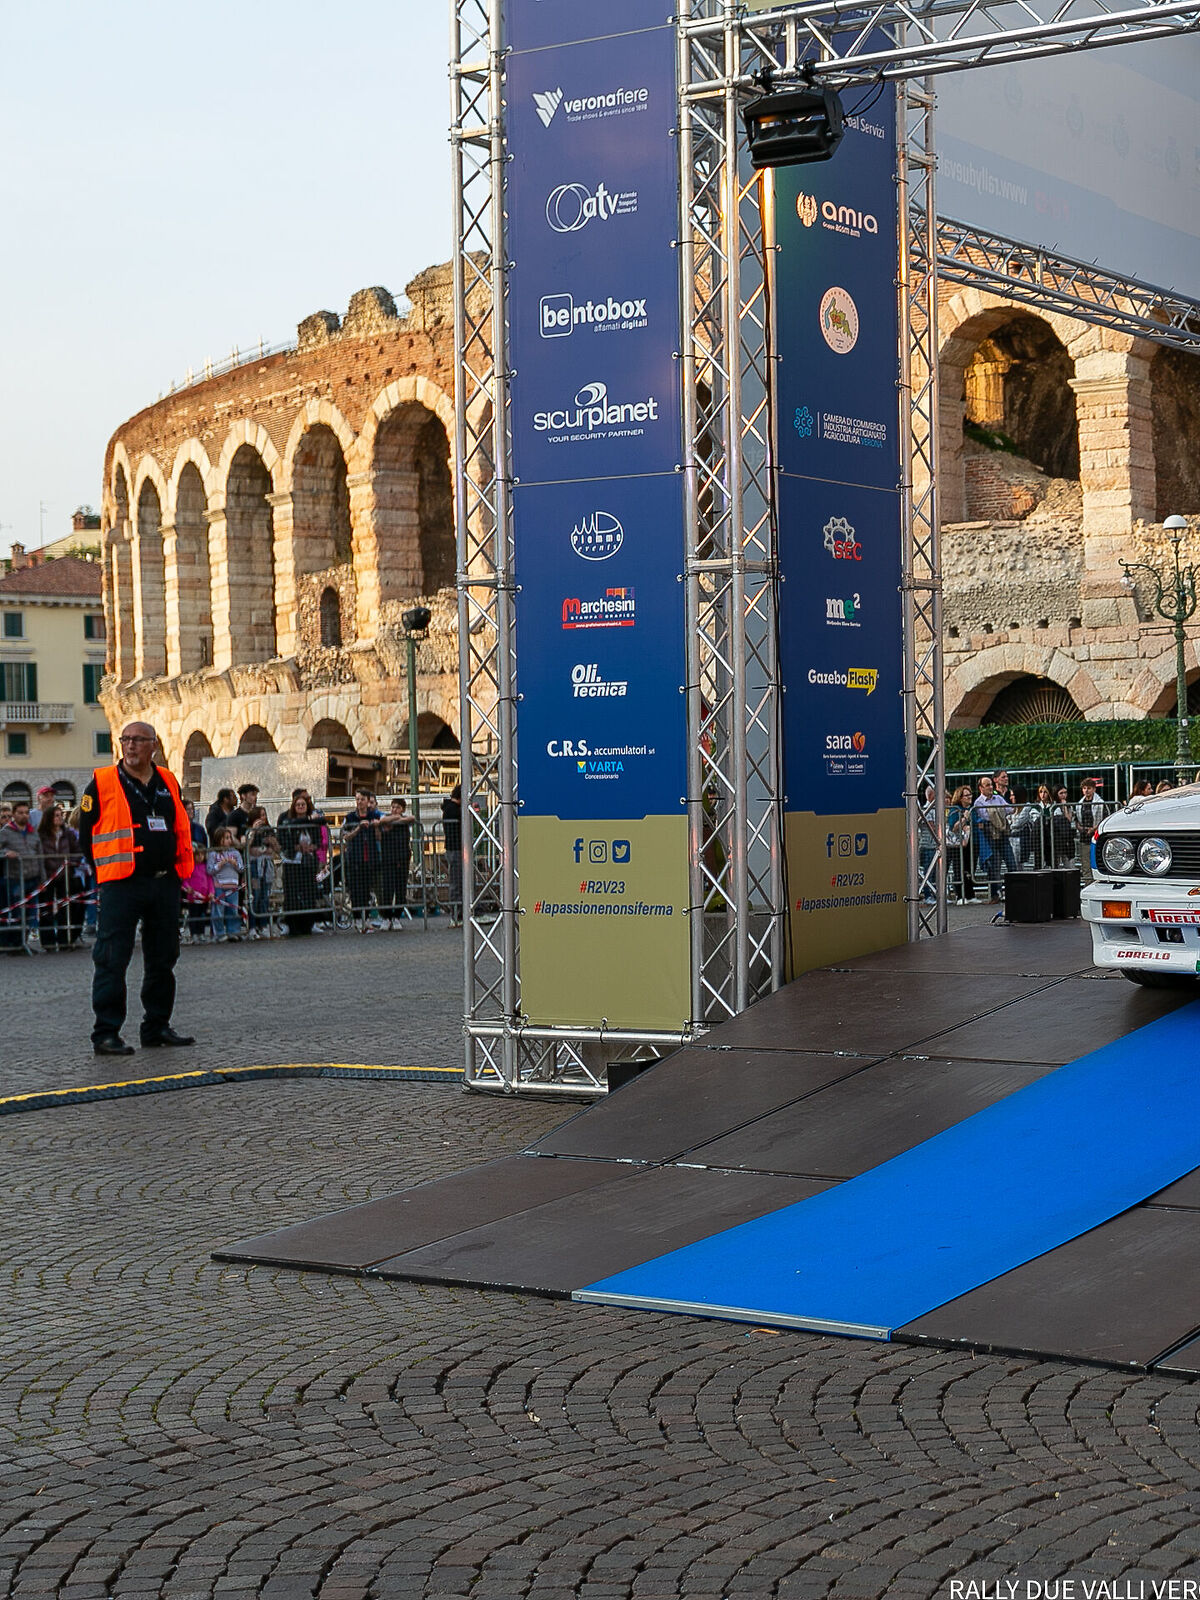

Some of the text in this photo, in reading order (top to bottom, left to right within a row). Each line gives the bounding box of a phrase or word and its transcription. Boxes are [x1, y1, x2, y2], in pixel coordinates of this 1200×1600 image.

[564, 87, 648, 113] veronafiere
[860, 117, 885, 140] Servizi
[582, 182, 619, 220] atv
[821, 201, 878, 234] amia
[543, 297, 647, 328] bentobox
[621, 318, 648, 330] digitali
[533, 394, 659, 431] sicurplanet
[548, 428, 644, 444] YOUR SECURITY PARTNER
[834, 540, 862, 561] SEC
[562, 598, 635, 622] Marchesini
[808, 668, 875, 686] Gazebo Flash
[572, 681, 628, 698] Tecnica
[547, 739, 592, 757] C.R.S.
[593, 745, 647, 756] accumulatori
[826, 734, 852, 750] sara
[588, 761, 625, 772] VARTA
[579, 880, 625, 894] #R2V23
[831, 873, 865, 888] #R2V23
[534, 900, 673, 917] #lapassionenonsiferma
[796, 891, 897, 913] #lapassionenonsiferma
[1117, 950, 1171, 960] CARELLO
